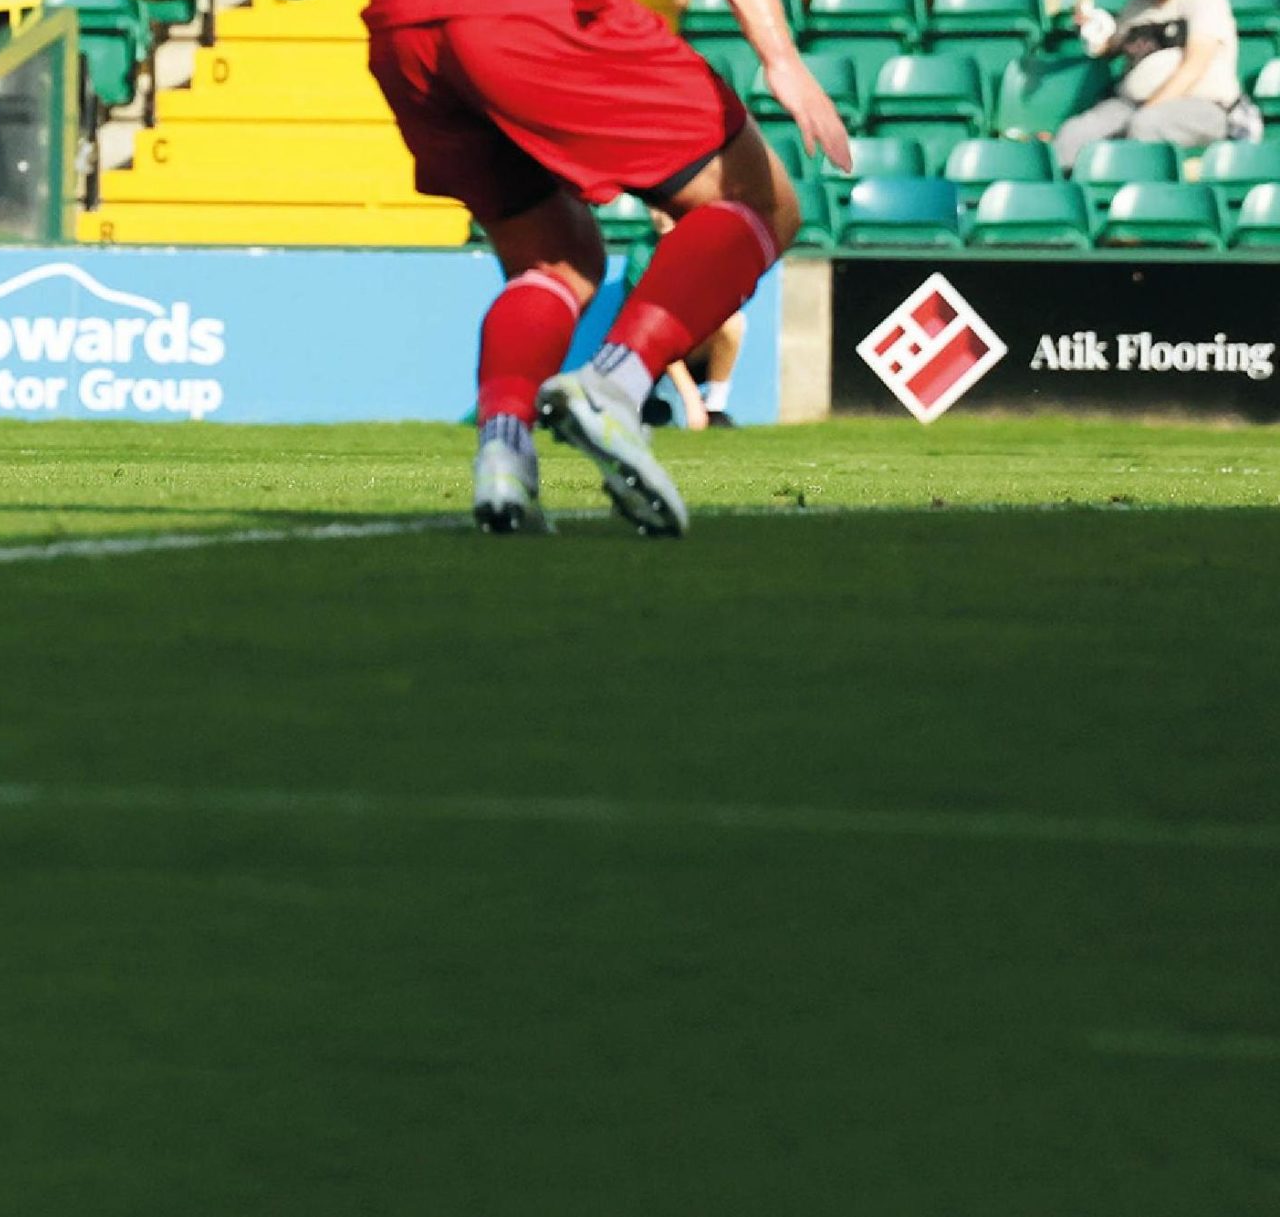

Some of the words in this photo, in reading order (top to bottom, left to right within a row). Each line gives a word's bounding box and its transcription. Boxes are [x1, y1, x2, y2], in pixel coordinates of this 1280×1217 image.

[152, 138, 169, 164] C
[1029, 331, 1110, 372] Atik
[1117, 331, 1276, 381] Flooring
[78, 368, 223, 421] Group
